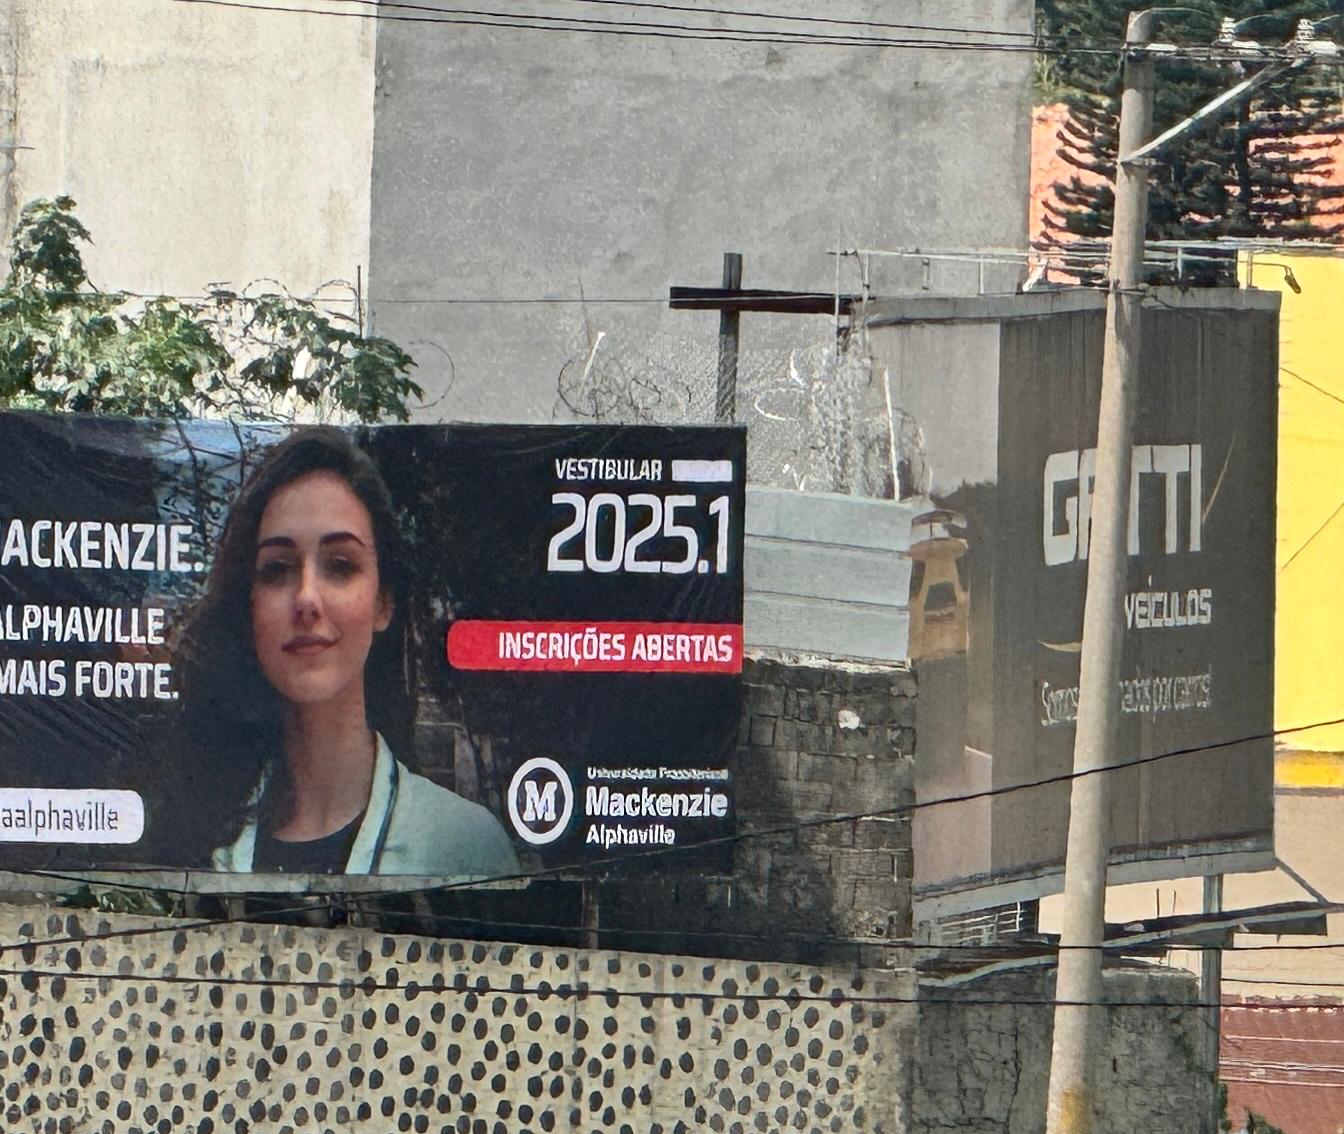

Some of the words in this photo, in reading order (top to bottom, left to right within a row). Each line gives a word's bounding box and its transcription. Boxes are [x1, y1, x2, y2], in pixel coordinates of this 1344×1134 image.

[555, 457, 663, 482] VESTIBULAR
[546, 491, 730, 575] 2025.1
[498, 627, 626, 666] INSCRIÇÕES
[631, 632, 733, 664] ABERTAS
[74, 660, 179, 701] FORTE.
[585, 785, 729, 817] Mackenzie
[585, 823, 676, 850] Alphaville
